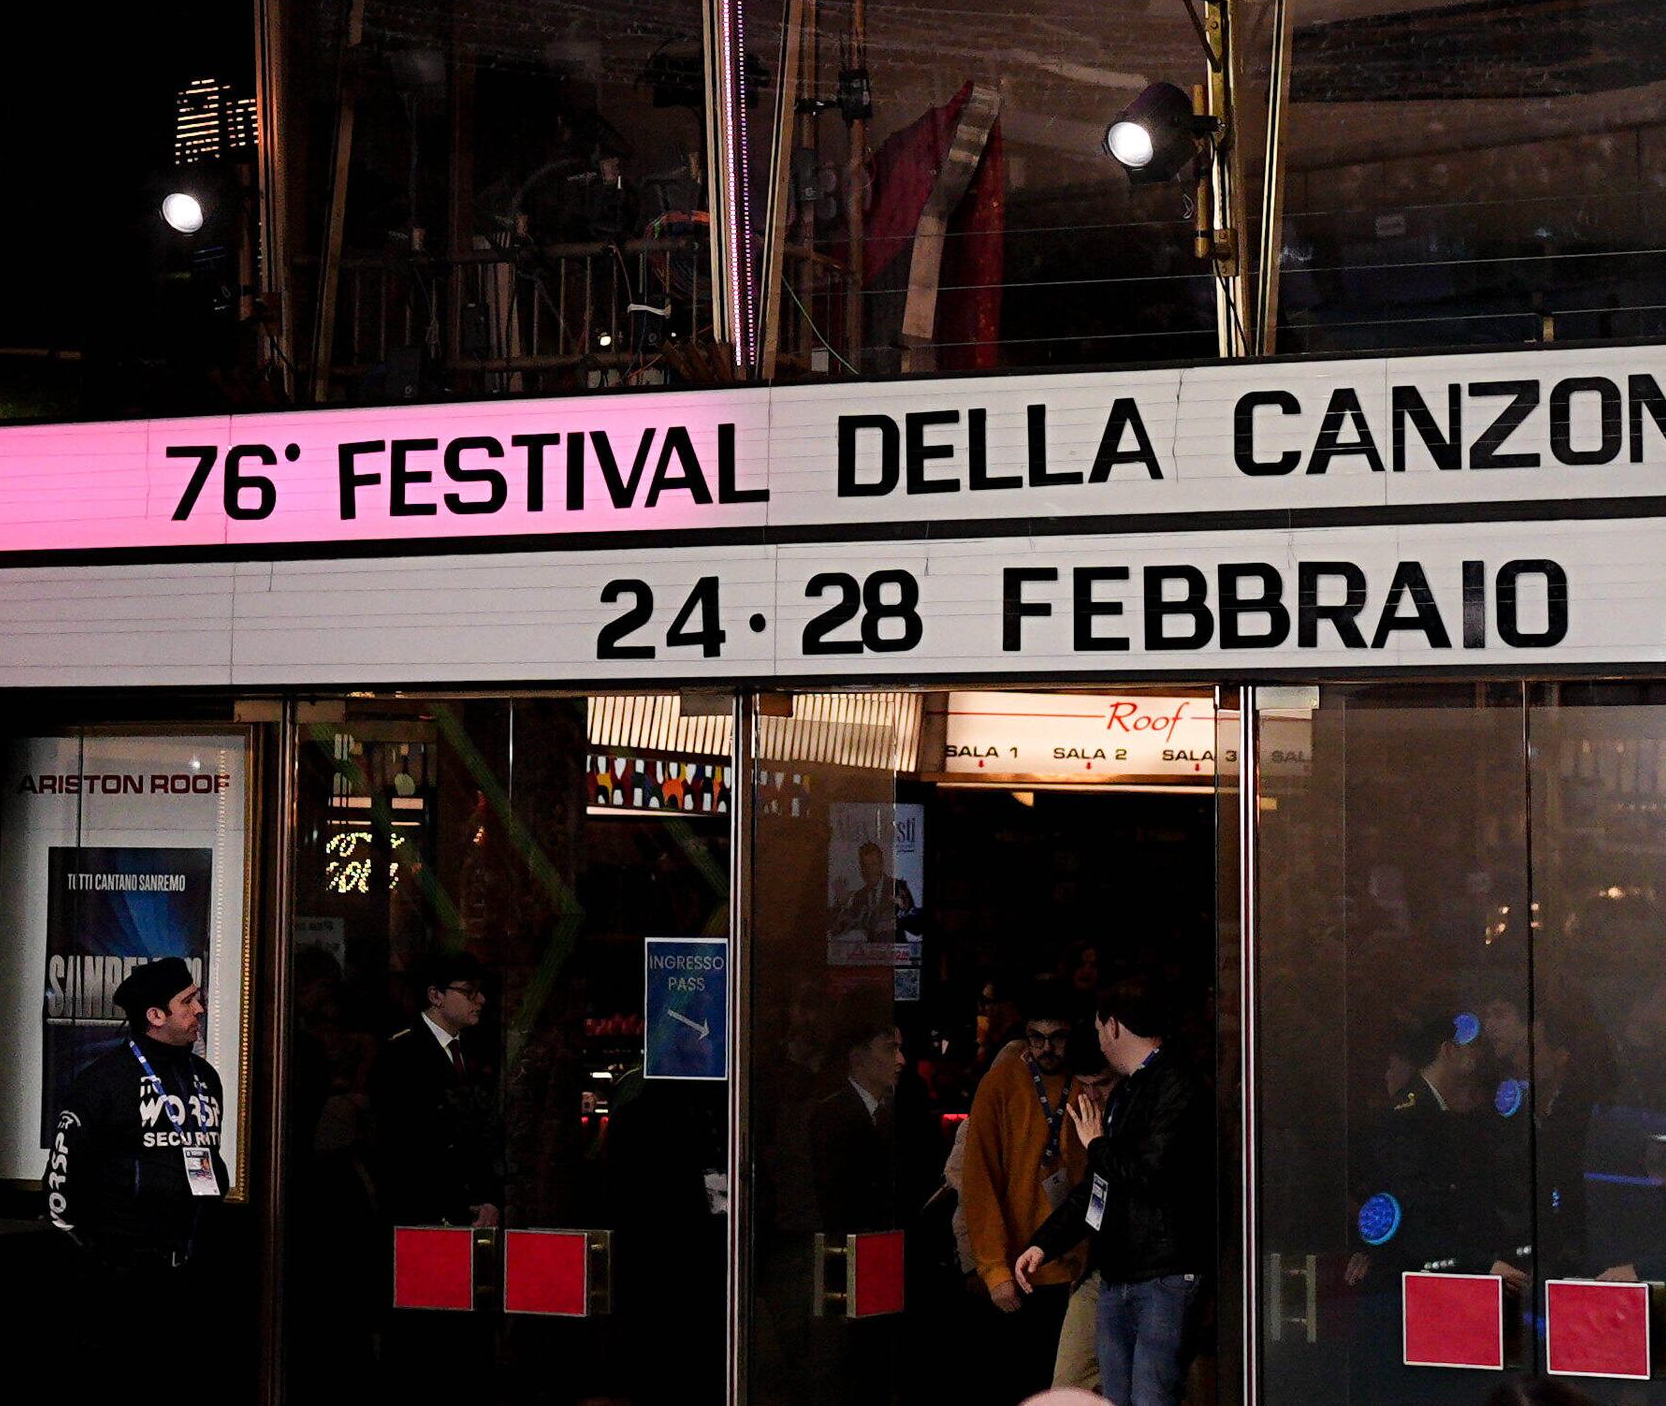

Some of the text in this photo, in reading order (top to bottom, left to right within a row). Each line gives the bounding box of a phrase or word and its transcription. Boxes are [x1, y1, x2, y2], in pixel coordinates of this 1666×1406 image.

[339, 424, 770, 520] FESTIVAL
[838, 398, 1163, 497] DELLA
[1003, 556, 1569, 654] FEBBRAIO
[1104, 700, 1191, 744] Roof
[946, 743, 1019, 759] SALA 1
[1053, 746, 1128, 762] SALA 2
[1162, 748, 1238, 763] SALA 3
[20, 774, 230, 794] ARISTON ROOF
[94, 873, 137, 892] CANTANO
[139, 874, 186, 893] SANREMO
[649, 955, 725, 970] INGRESSO
[668, 977, 706, 992] PASS
[143, 1132, 221, 1147] SECURIT
